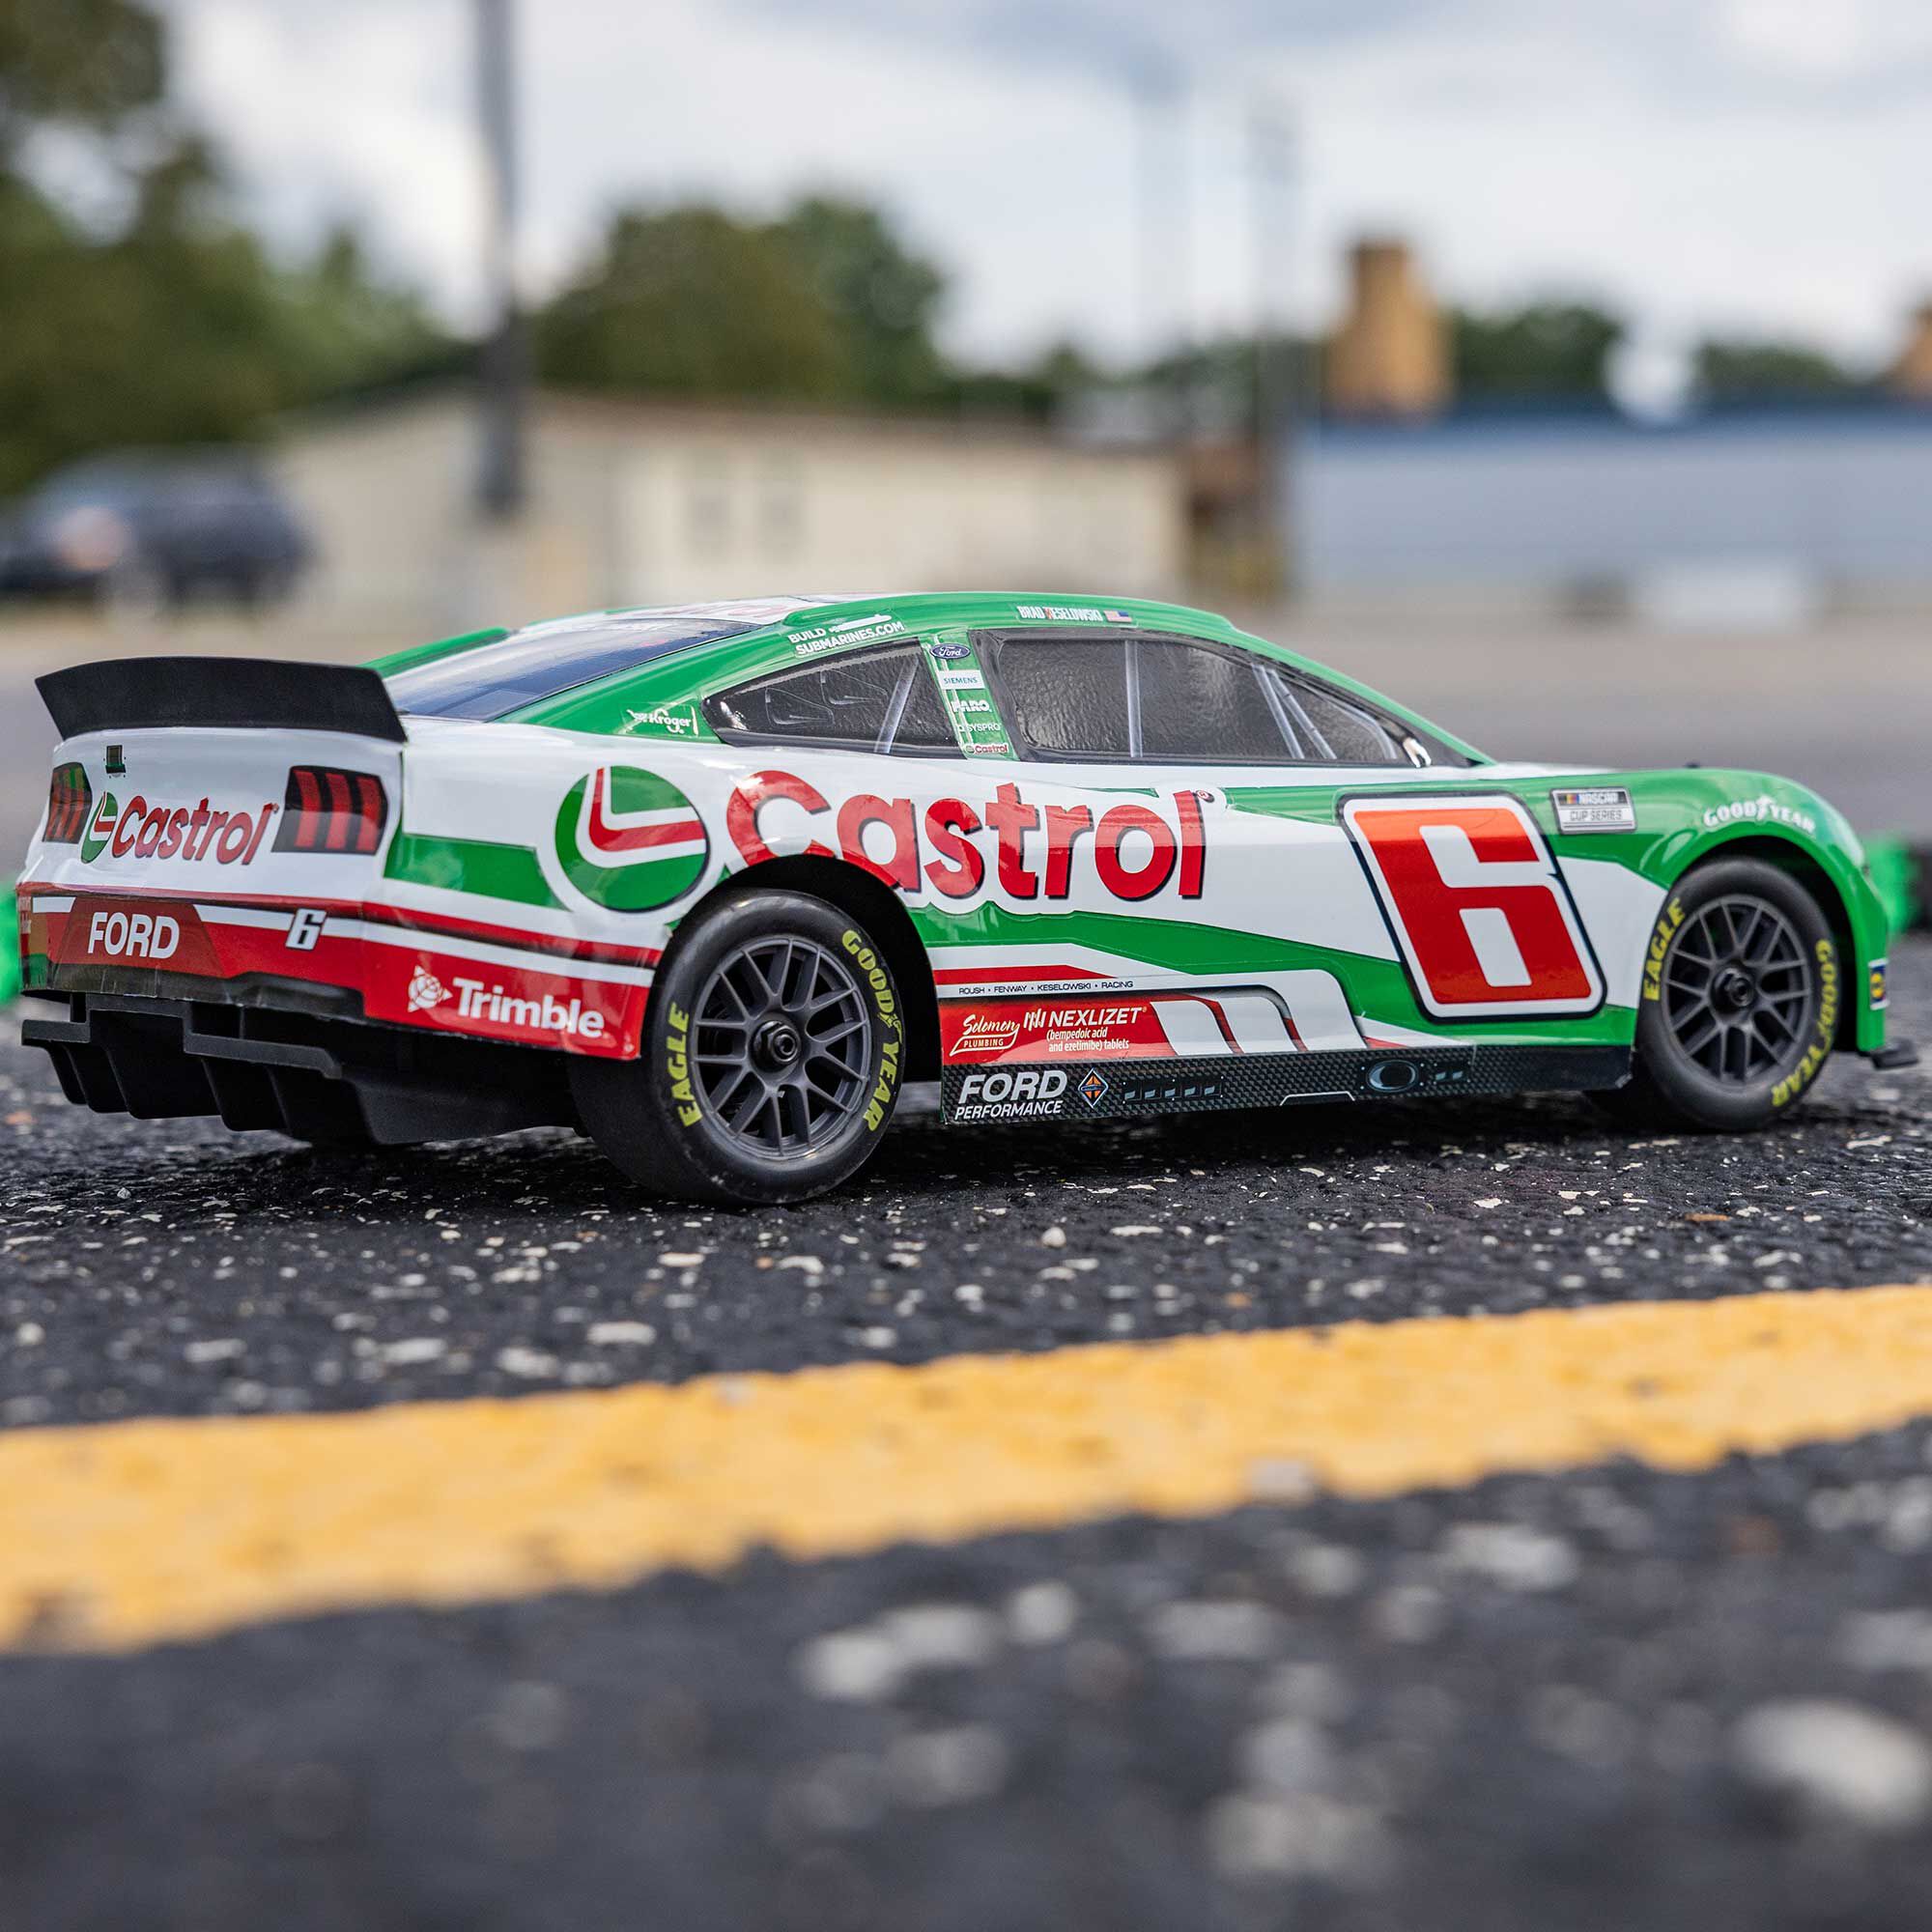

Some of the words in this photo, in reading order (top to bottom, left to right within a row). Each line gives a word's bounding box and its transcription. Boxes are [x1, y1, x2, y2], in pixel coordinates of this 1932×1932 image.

[788, 628, 826, 643] BUILD
[795, 621, 905, 656] SUBMARINES.COM
[938, 646, 962, 657] Ford
[649, 708, 692, 733] Kroger
[967, 723, 1001, 731] SYSPRO
[975, 744, 1008, 753] Castrol
[1579, 793, 1618, 804] NASCAR
[1570, 810, 1589, 821] CUP
[1590, 810, 1622, 821] SERIES
[112, 795, 274, 866] Castrol
[726, 770, 1208, 900] Castrol
[1353, 808, 1592, 1005] 6
[87, 912, 180, 959] FORD
[285, 908, 327, 952] 6
[1643, 896, 1687, 1002] EAGLE
[958, 986, 985, 995] ROUSH
[993, 984, 1027, 993] FENWAY
[1037, 982, 1092, 991] KESELOWSKI
[1101, 980, 1134, 989] RACING
[452, 977, 605, 1038] Trimble
[1048, 1007, 1142, 1027] NEXLIZET
[963, 1037, 1004, 1048] PLUMBING
[1092, 1027, 1108, 1038] acid
[1048, 1042, 1064, 1052] and
[1104, 1037, 1129, 1050] tablets
[666, 1002, 703, 1127] EAGLE
[958, 1070, 1067, 1104] FORD
[954, 1099, 1063, 1121] PERFORMANCE
